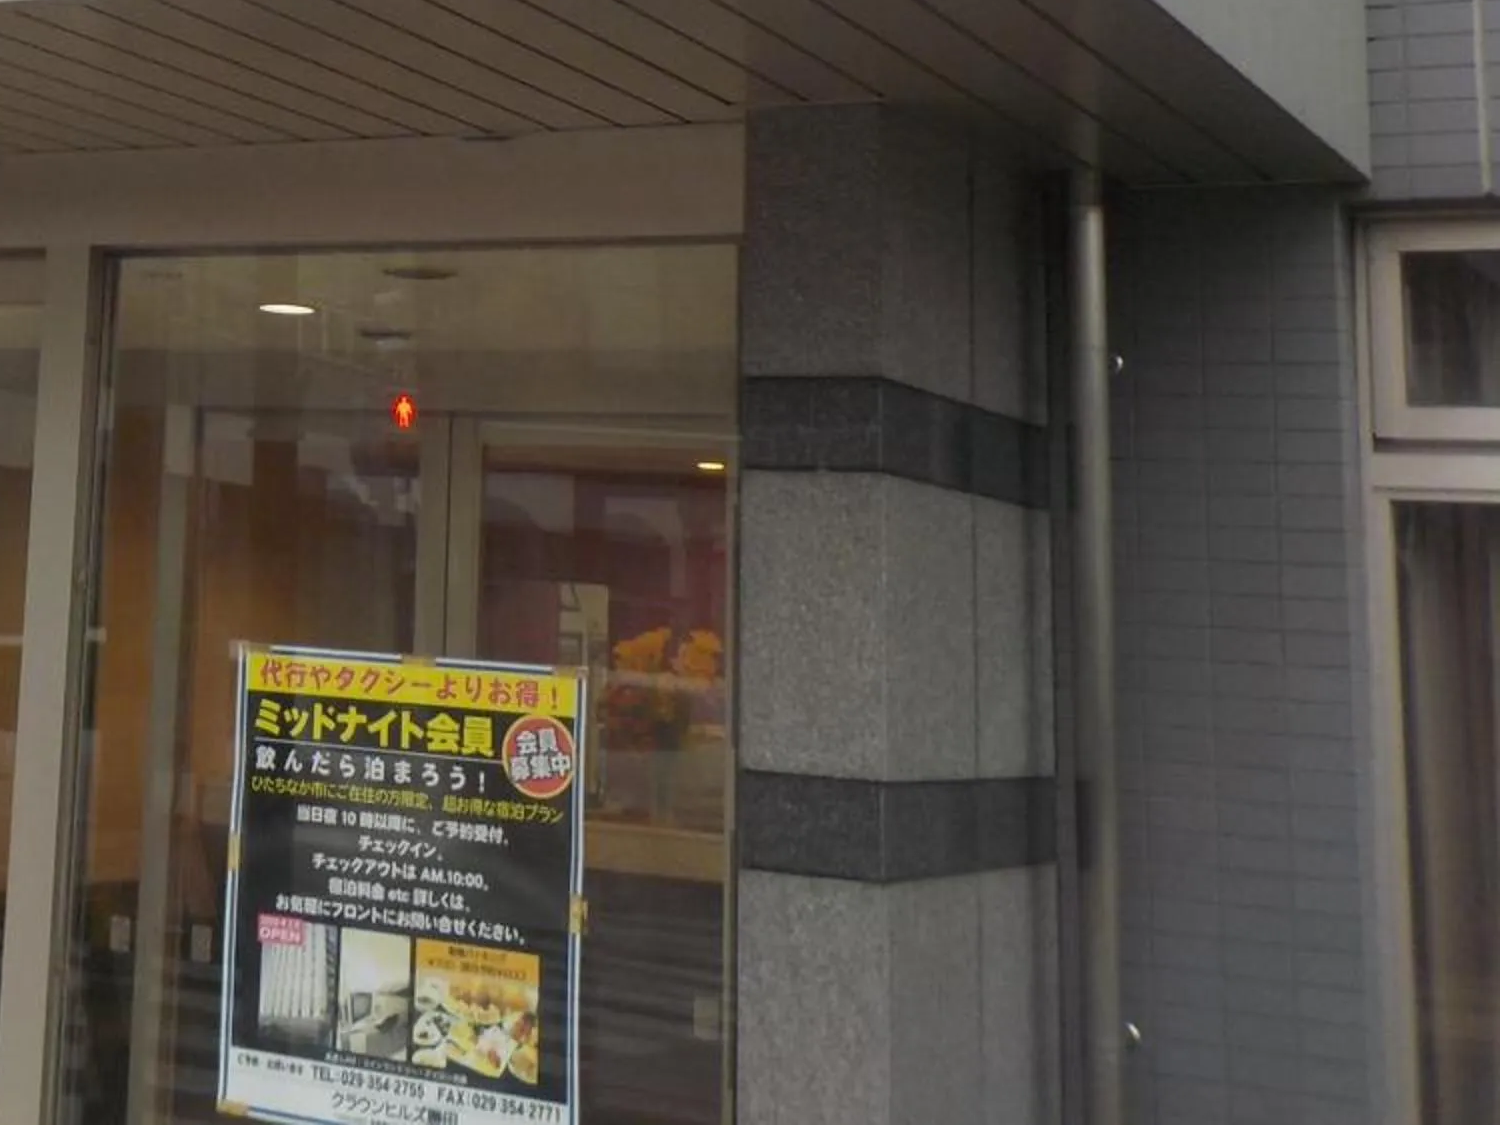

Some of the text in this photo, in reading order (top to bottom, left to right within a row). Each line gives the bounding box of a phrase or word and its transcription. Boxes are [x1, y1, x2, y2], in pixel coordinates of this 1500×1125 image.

[255, 698, 495, 757] ミッドナイト会員
[259, 927, 302, 944] OPEN
